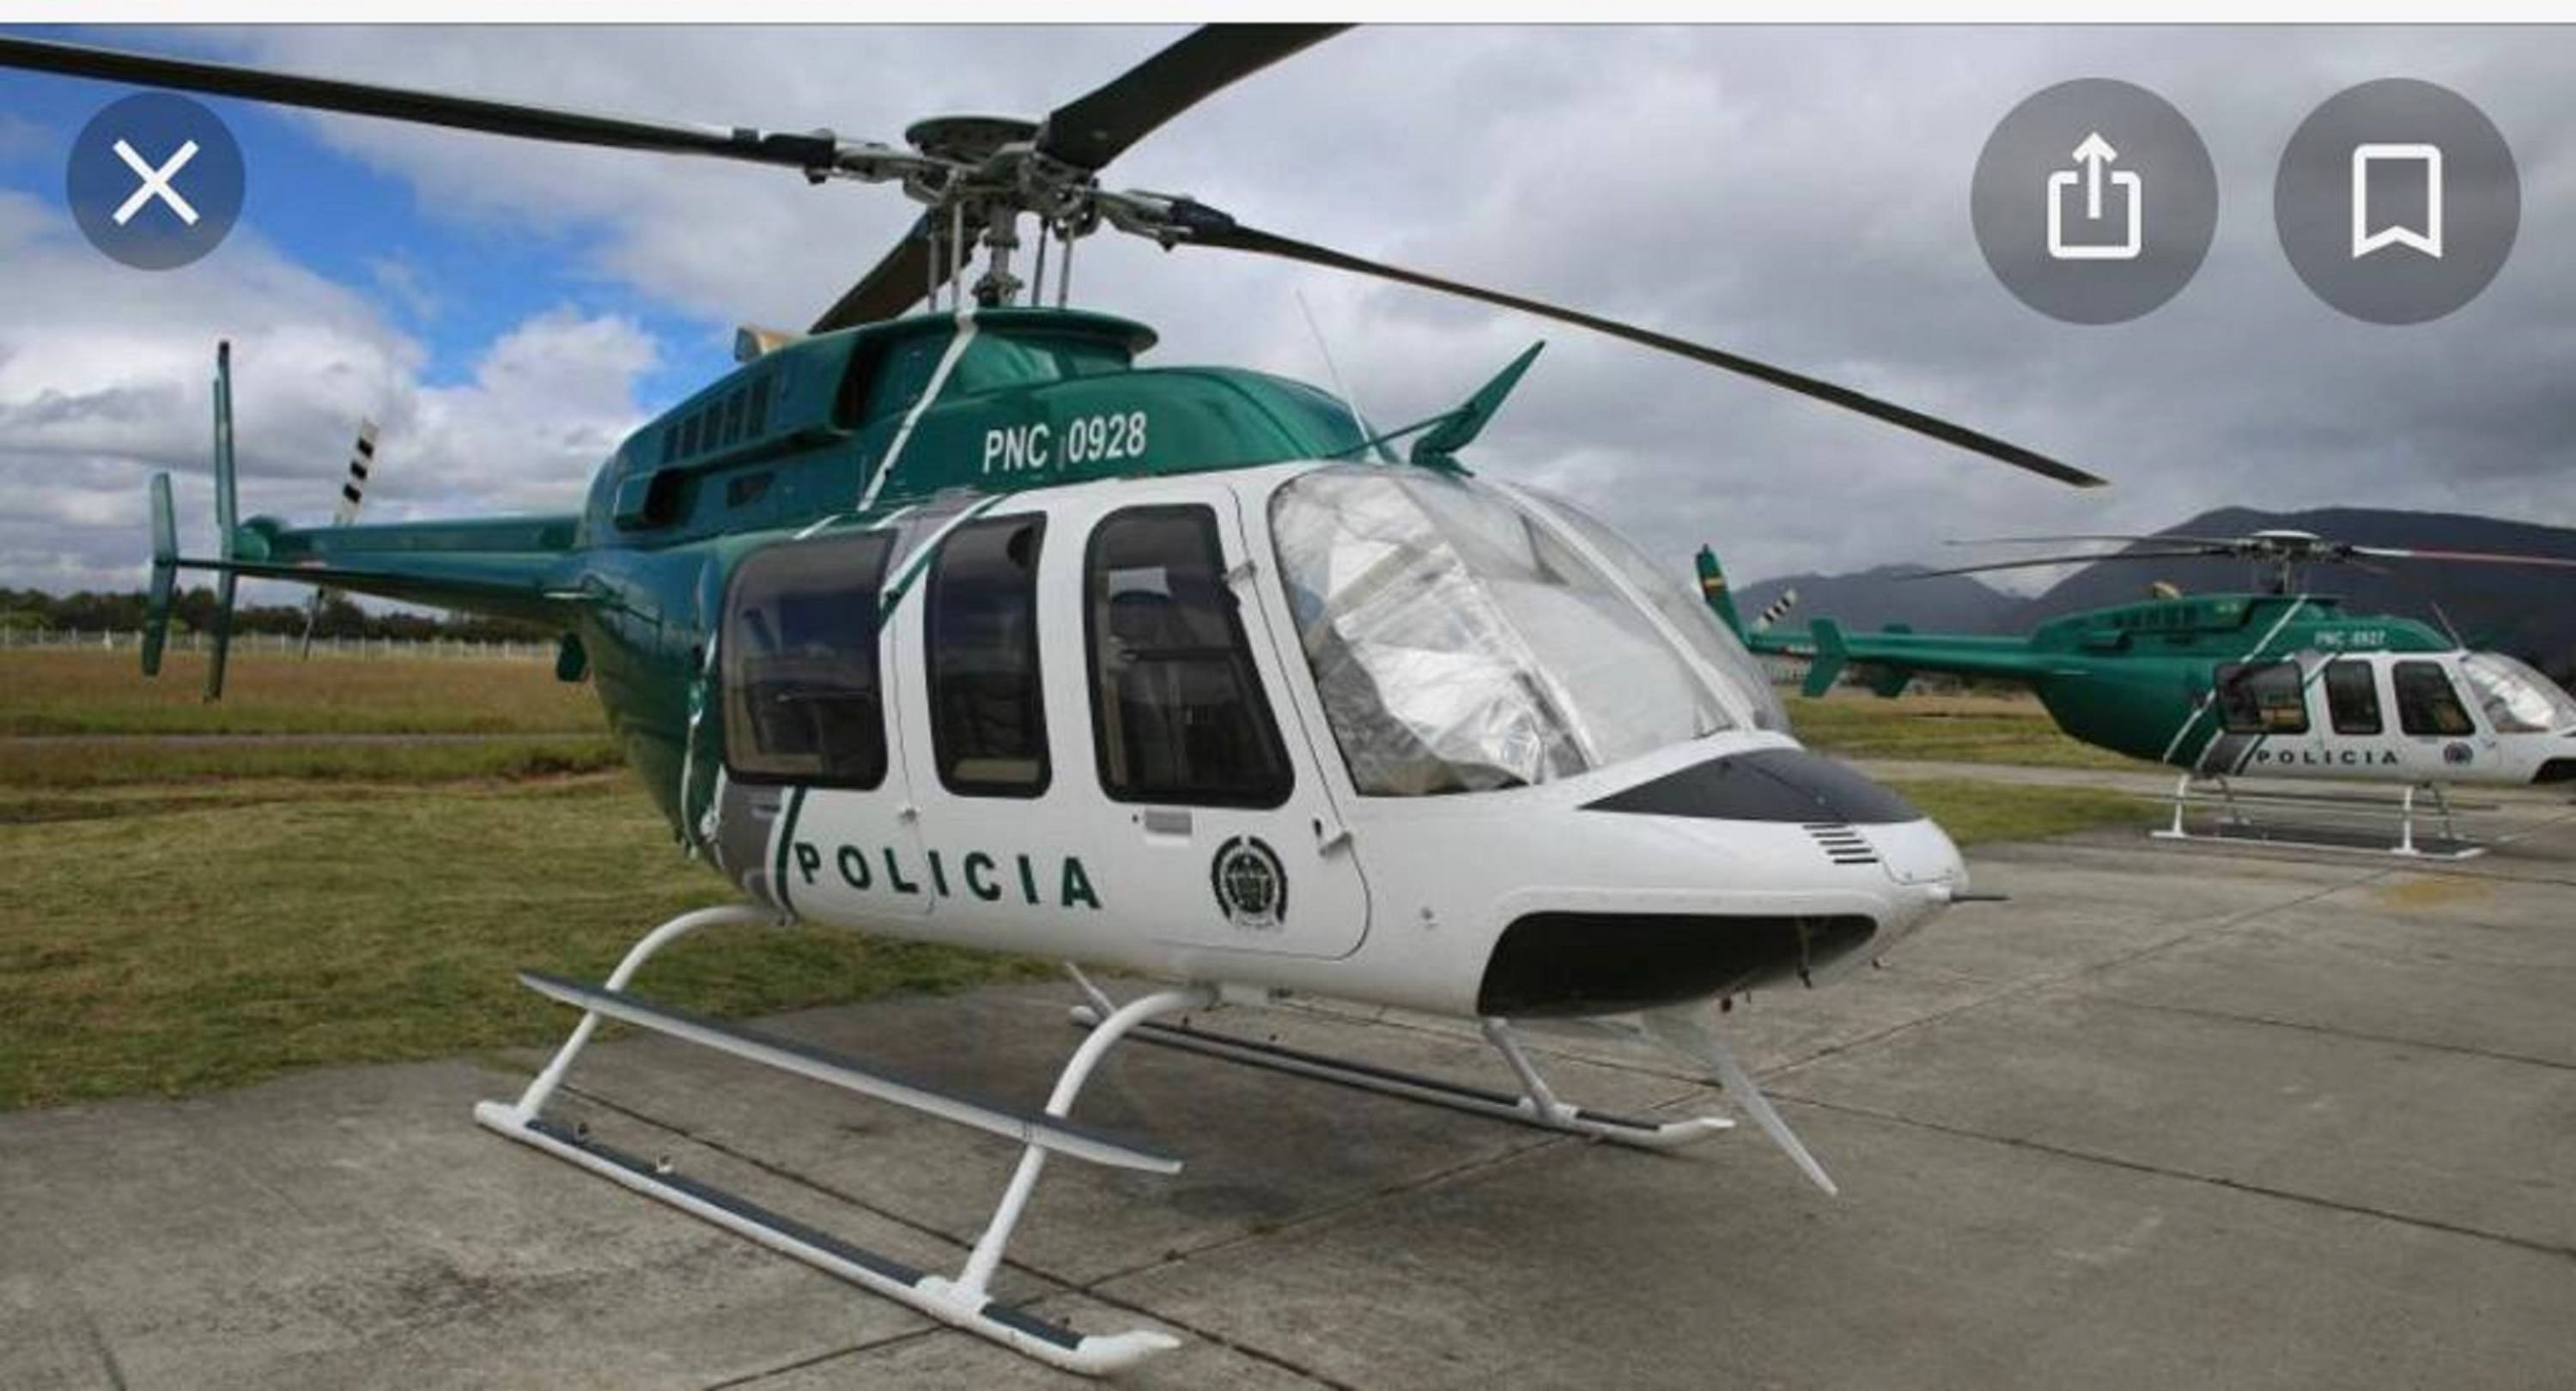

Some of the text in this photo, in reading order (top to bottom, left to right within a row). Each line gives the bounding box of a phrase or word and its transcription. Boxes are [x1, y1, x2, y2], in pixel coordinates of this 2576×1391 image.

[983, 410, 1146, 473] PNC 0928
[2256, 749, 2399, 766] POLICIA
[793, 842, 1102, 910] POLICIA
